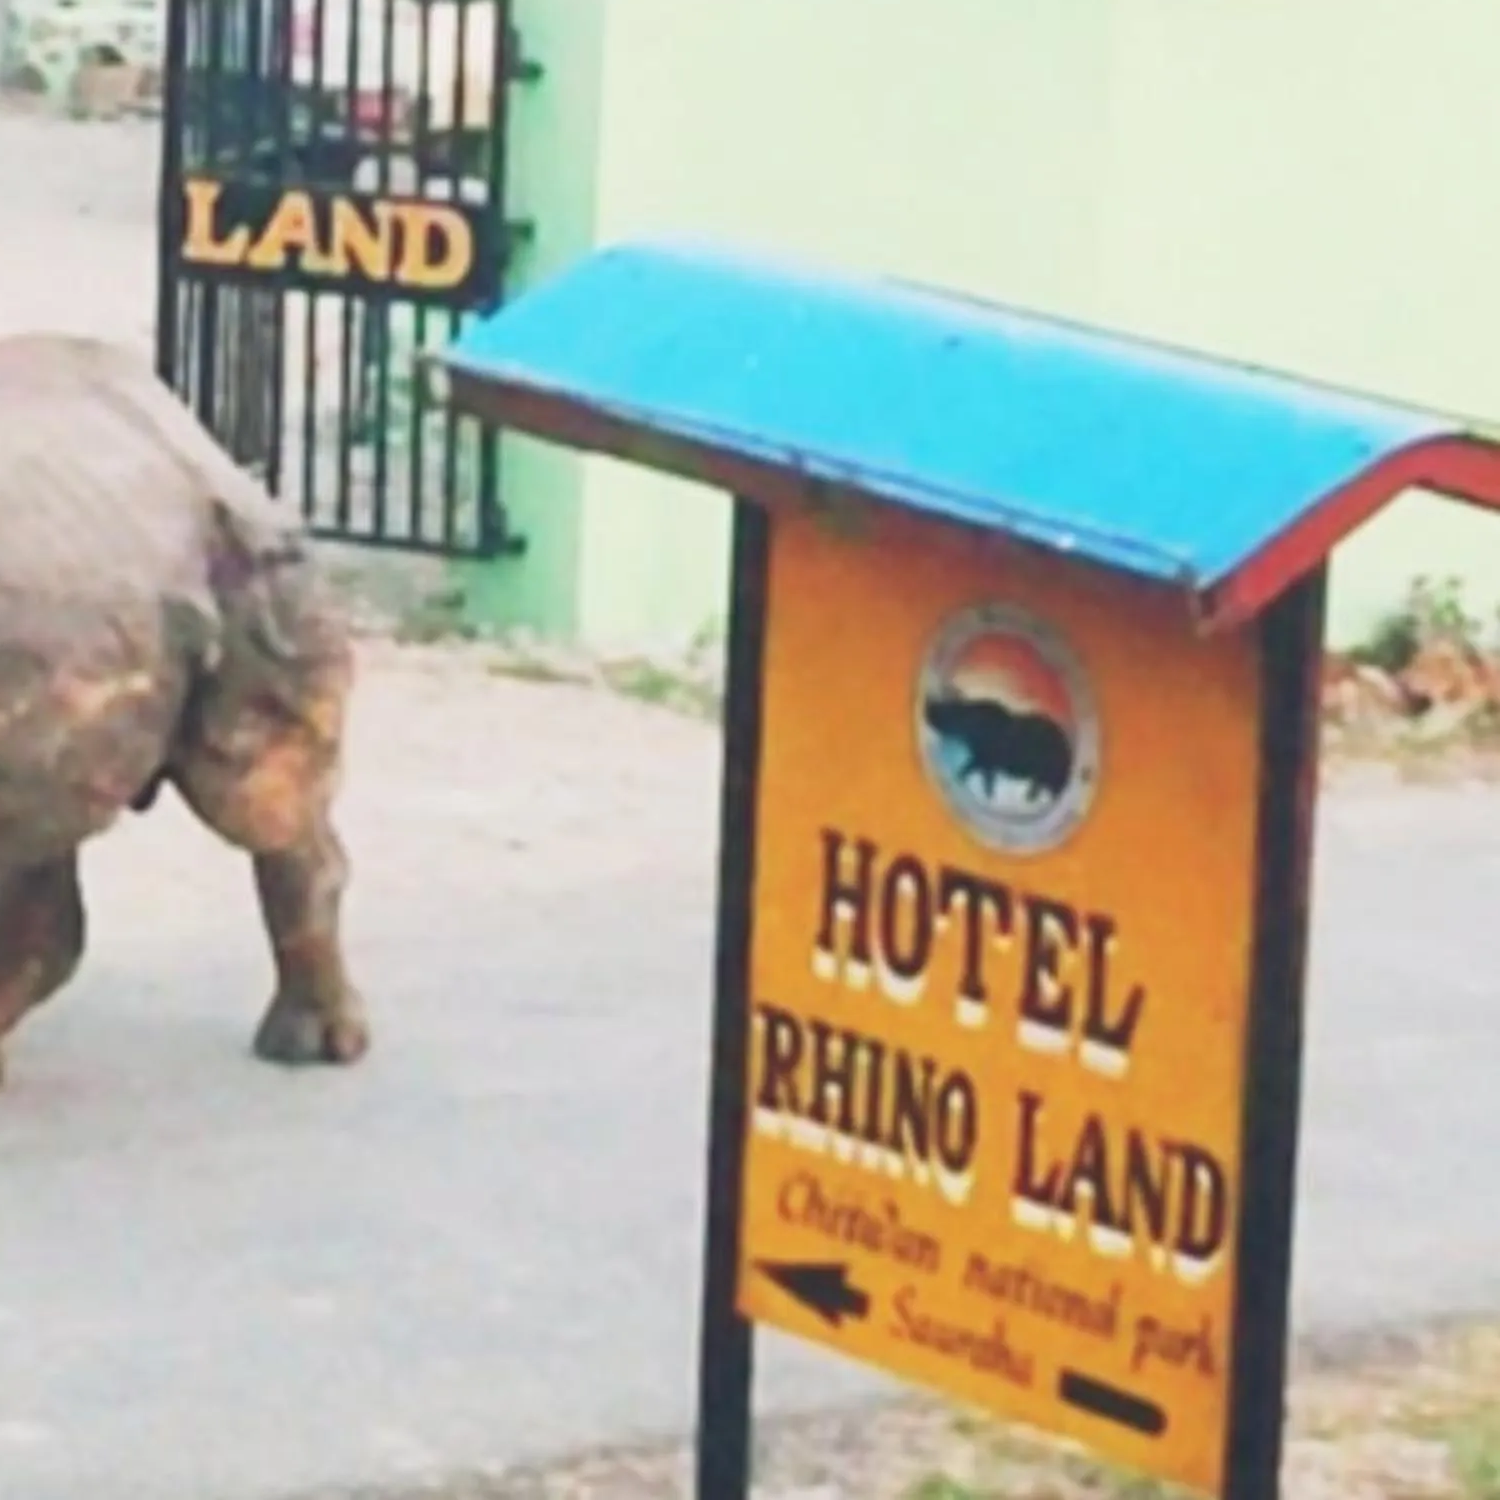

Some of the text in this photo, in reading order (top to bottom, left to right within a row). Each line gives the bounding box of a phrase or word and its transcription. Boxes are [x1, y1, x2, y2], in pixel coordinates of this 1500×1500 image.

[182, 177, 473, 288] LAND
[811, 827, 1147, 1078] HOTEL
[753, 1002, 1228, 1286] RHINO LAND
